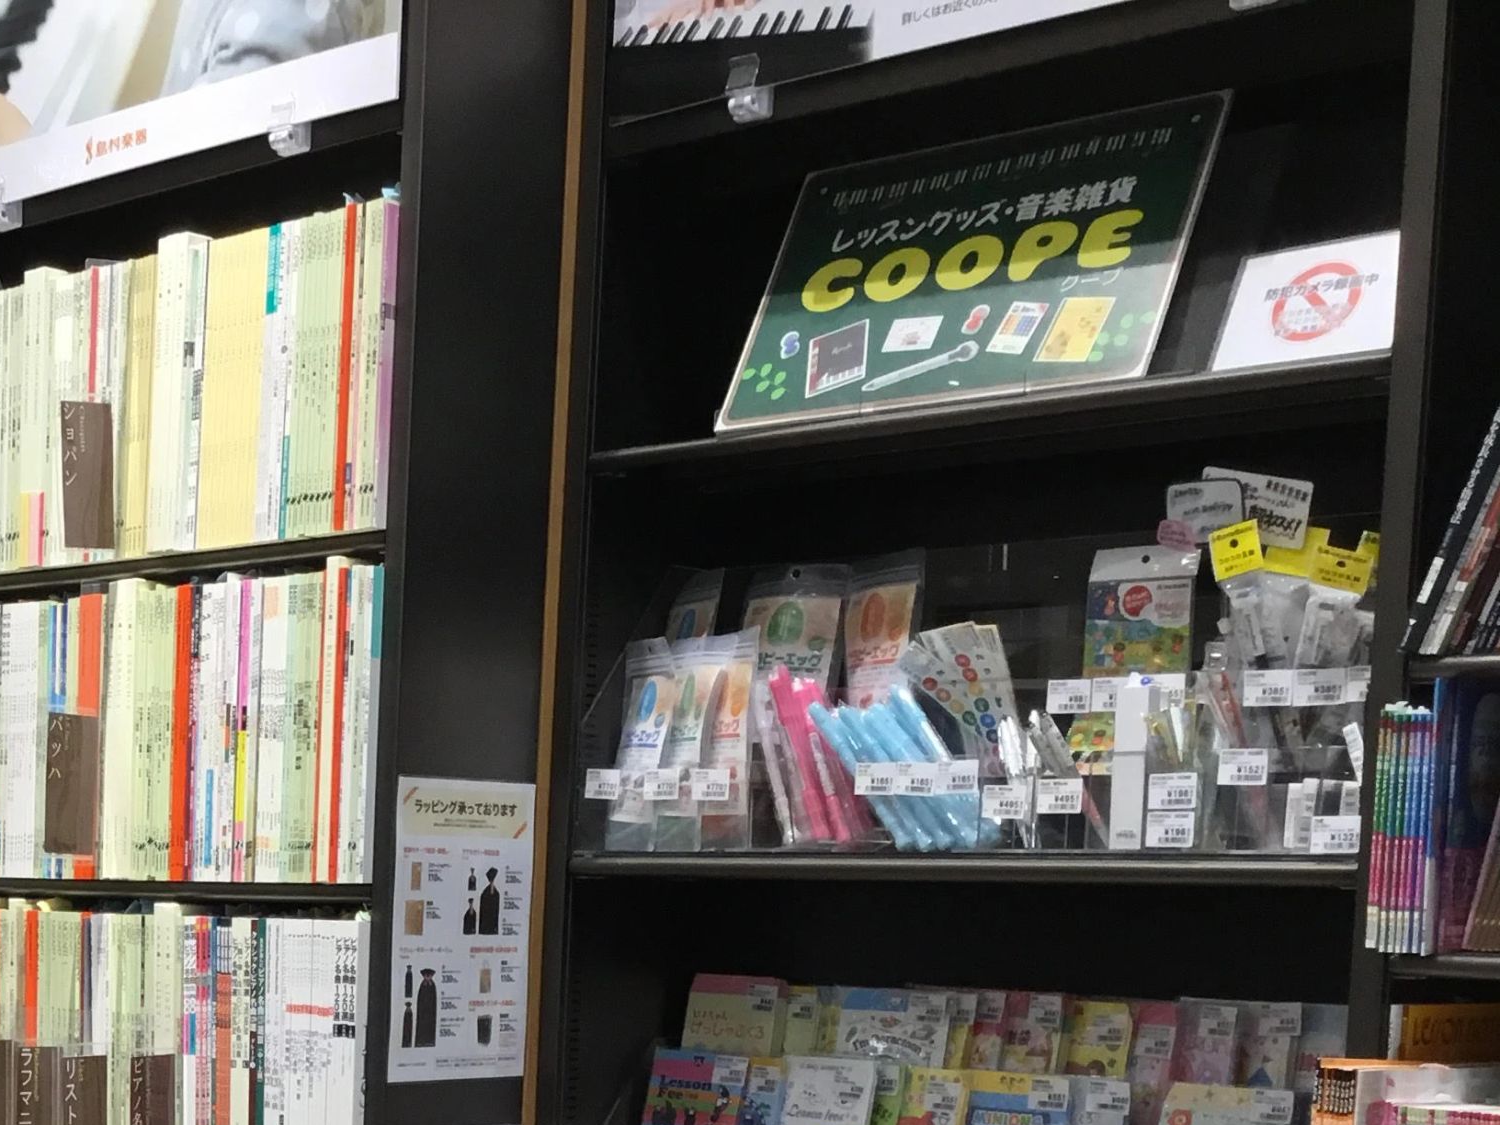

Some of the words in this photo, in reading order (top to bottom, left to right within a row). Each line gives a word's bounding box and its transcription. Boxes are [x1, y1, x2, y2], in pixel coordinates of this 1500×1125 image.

[831, 176, 1138, 253] レッスングッズ・音楽雑貨
[801, 209, 1144, 312] COOPE
[1059, 267, 1123, 292] クープ
[1264, 273, 1381, 302] 防犯カメラ録画中
[63, 403, 77, 487] ショパン
[414, 799, 518, 818] ラッピング承っております
[66, 1059, 78, 1125] リスト
[659, 1074, 712, 1091] Lesson
